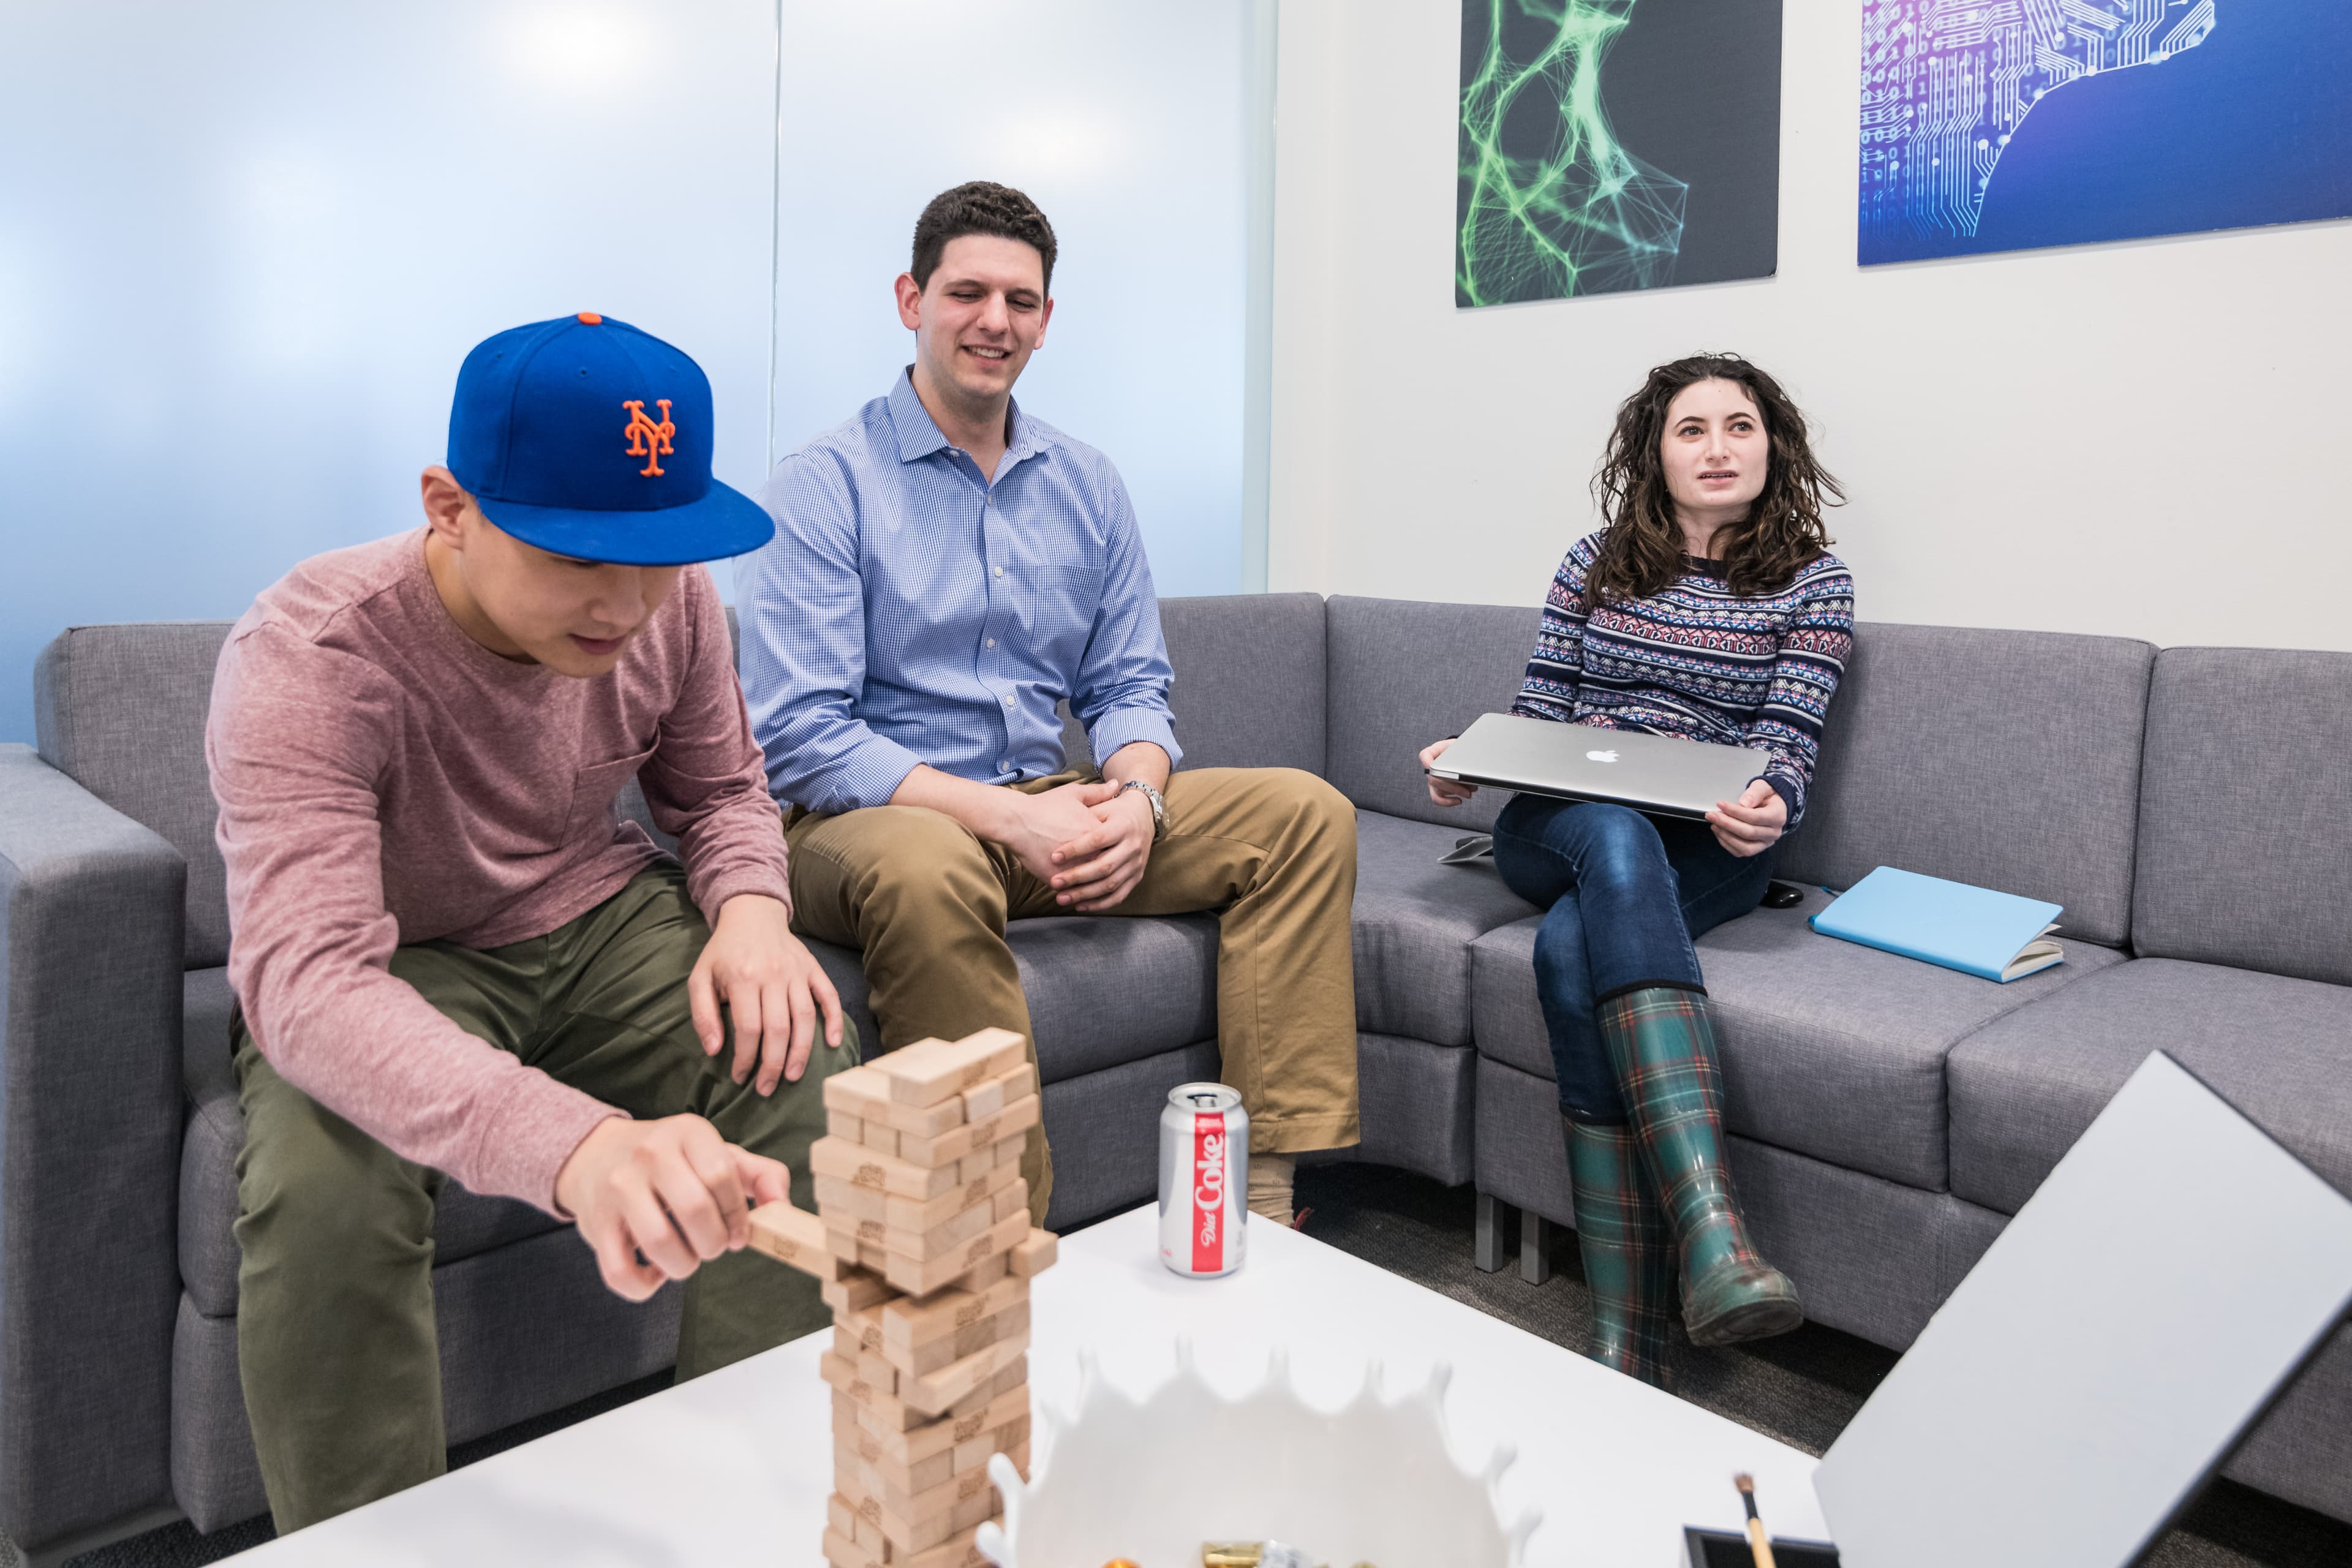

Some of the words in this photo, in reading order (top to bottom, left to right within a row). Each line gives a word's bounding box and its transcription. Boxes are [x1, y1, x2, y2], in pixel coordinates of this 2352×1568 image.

[622, 399, 675, 477] NY
[1195, 1133, 1224, 1210] Coke
[1200, 1210, 1216, 1248] Diet
